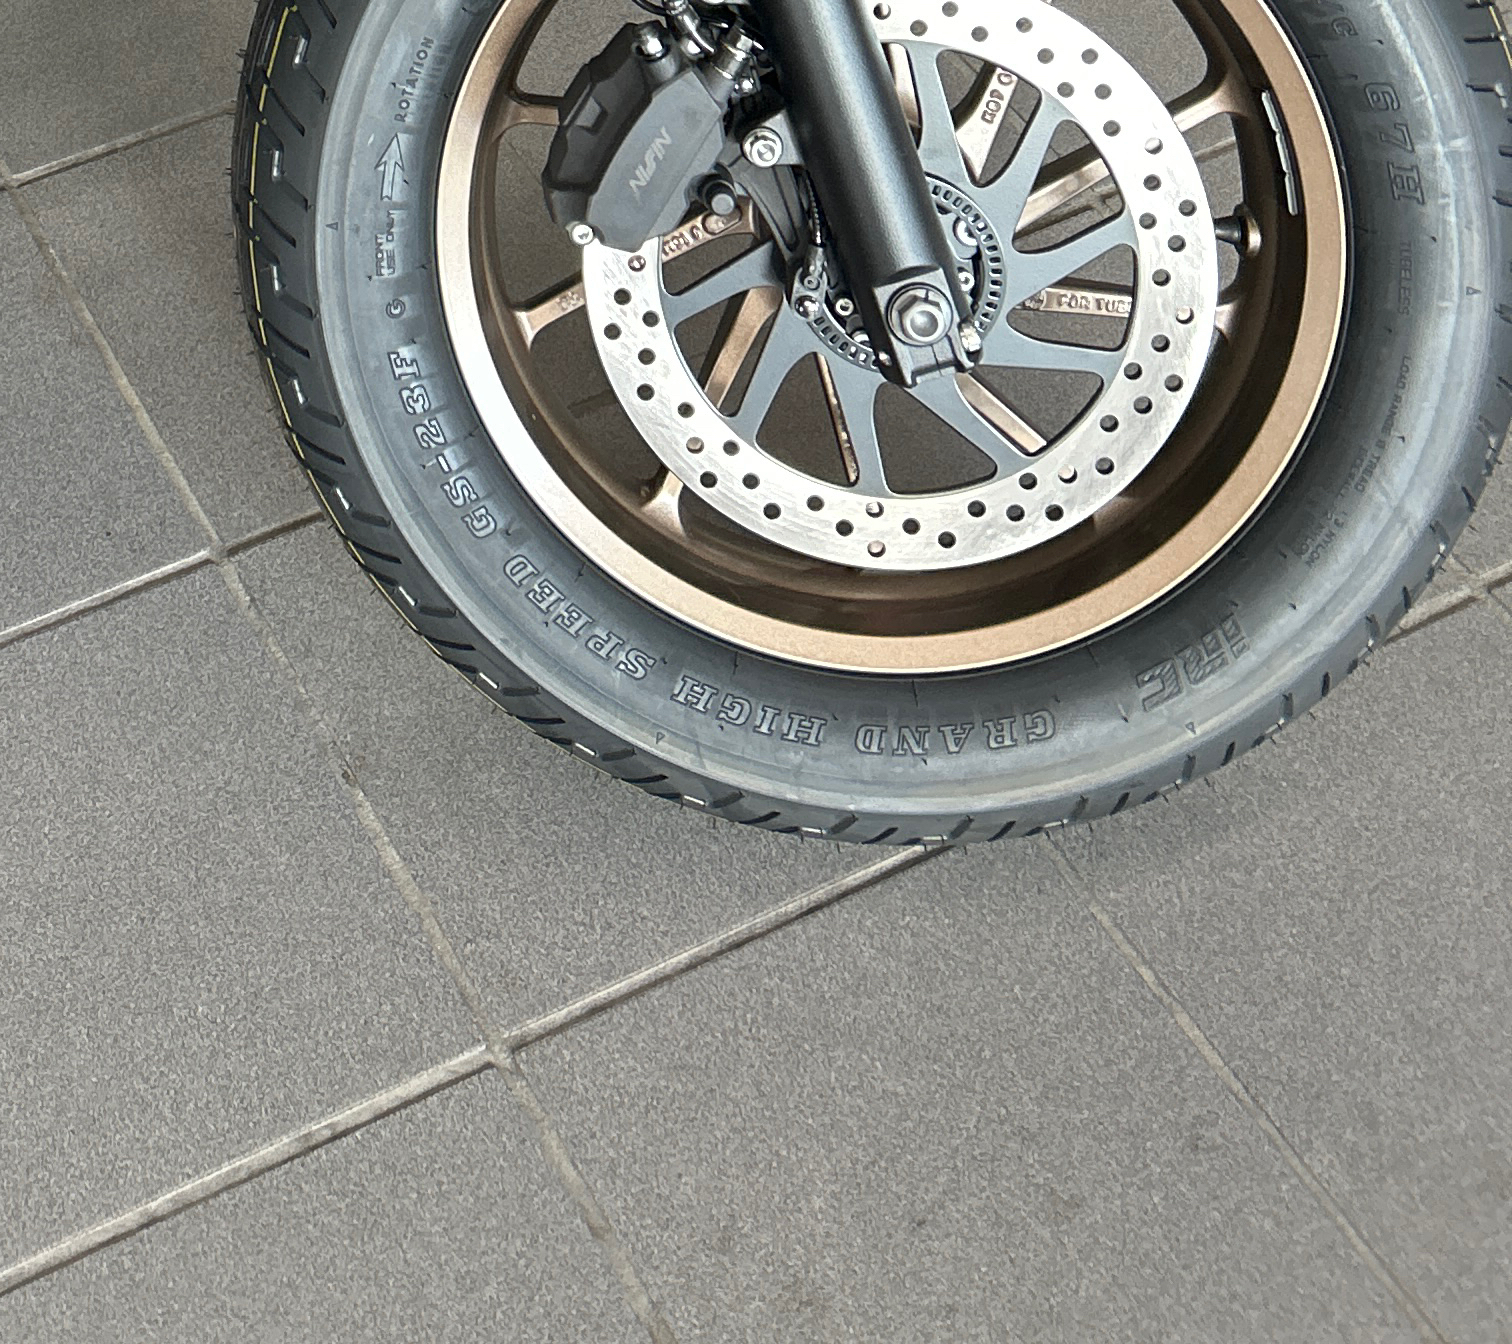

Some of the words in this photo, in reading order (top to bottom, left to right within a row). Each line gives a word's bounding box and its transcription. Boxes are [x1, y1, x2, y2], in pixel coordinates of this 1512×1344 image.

[394, 36, 434, 123] ROTATION
[1362, 79, 1425, 206] 67H
[388, 352, 496, 539] GS-23F
[503, 553, 657, 683] SPEED
[672, 674, 829, 749] HIGH
[854, 707, 1056, 758] GRAND
